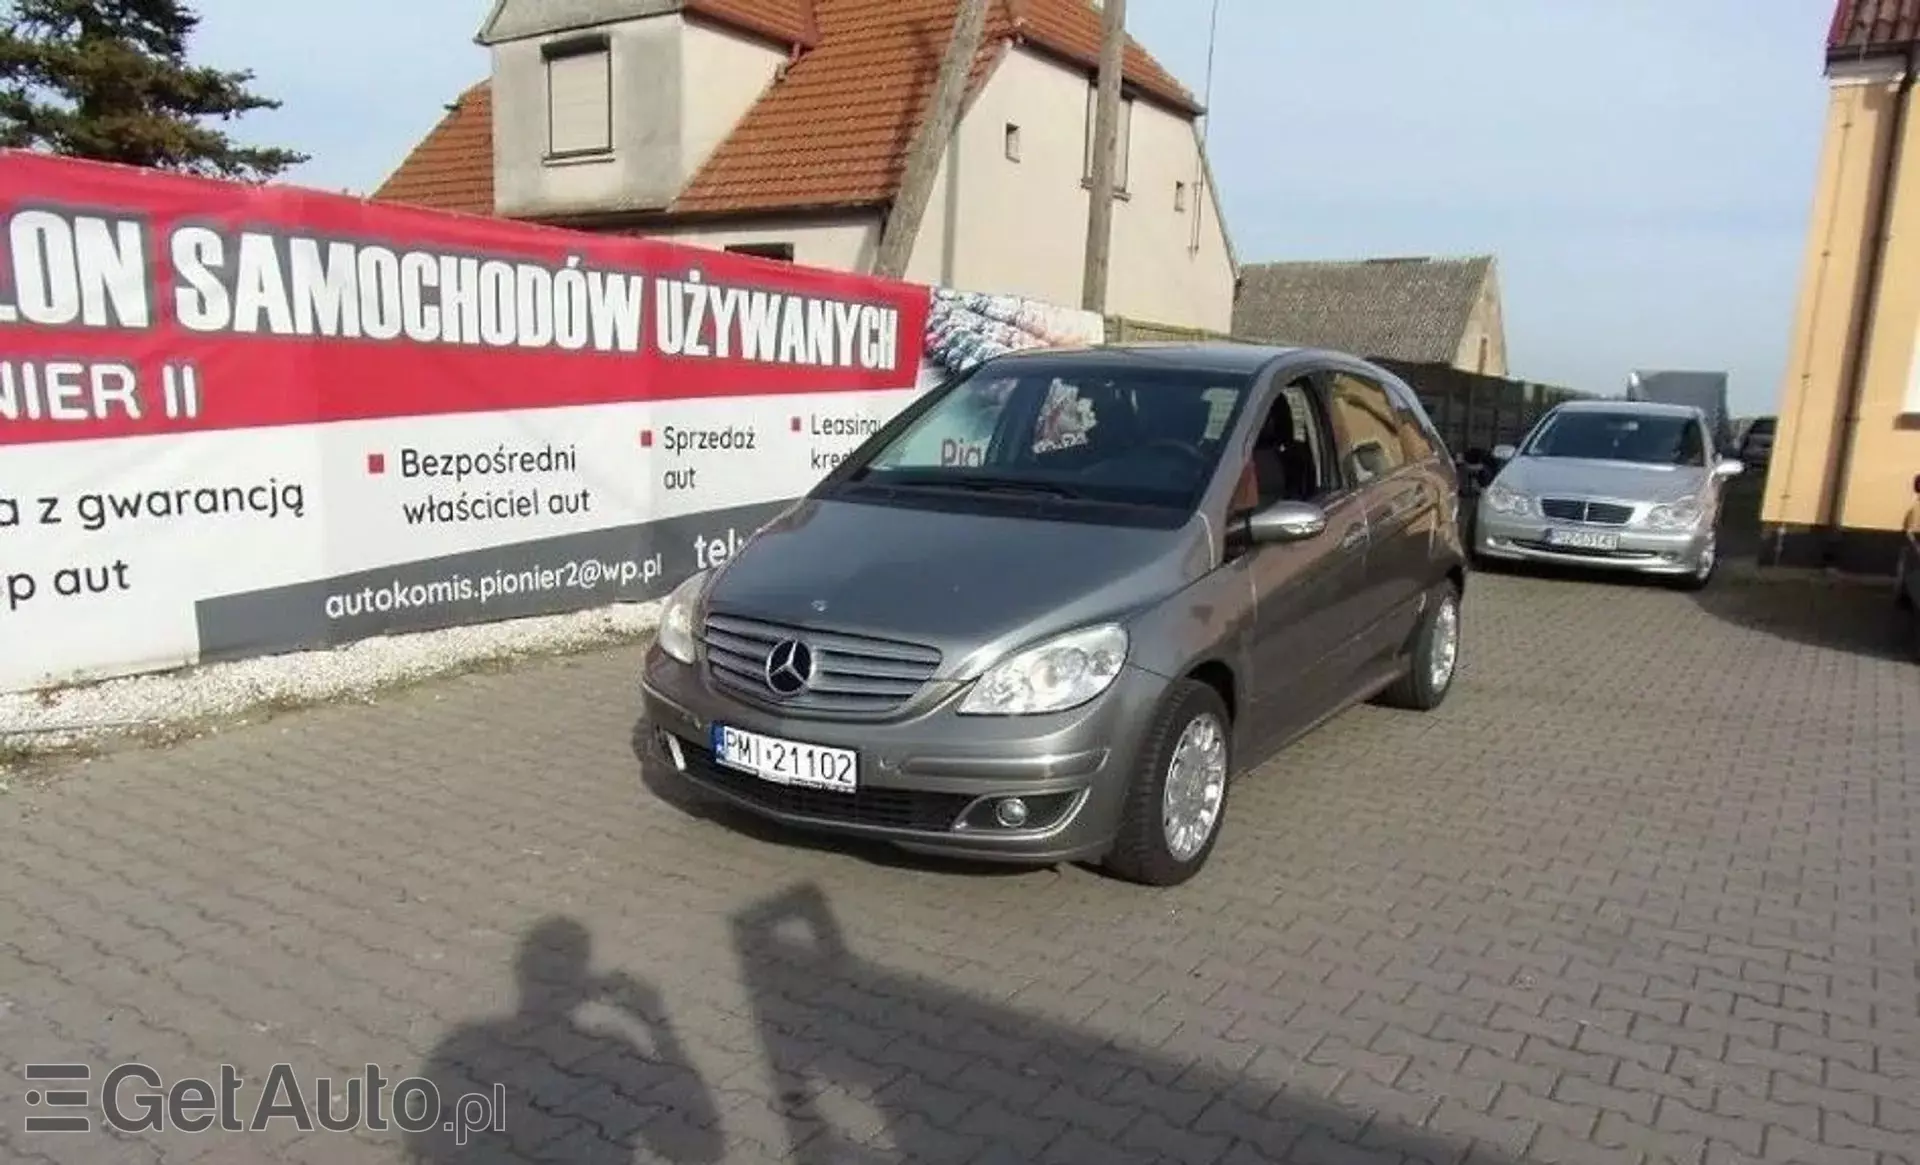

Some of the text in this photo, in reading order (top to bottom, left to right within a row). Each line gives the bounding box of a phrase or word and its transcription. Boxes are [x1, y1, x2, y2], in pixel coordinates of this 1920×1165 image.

[0, 209, 898, 370] ON SAMOCHODÓW UŻYWANYCH
[162, 364, 197, 420] II
[663, 425, 755, 459] Sprzedaż
[401, 444, 577, 482] Bezpośredni
[663, 469, 696, 490] aut
[36, 497, 62, 524] z
[77, 478, 304, 531] gwarancją
[403, 488, 592, 525] właściciel aut
[54, 559, 131, 595] aut
[325, 553, 662, 618] autokomis.pionier2@wp.pl
